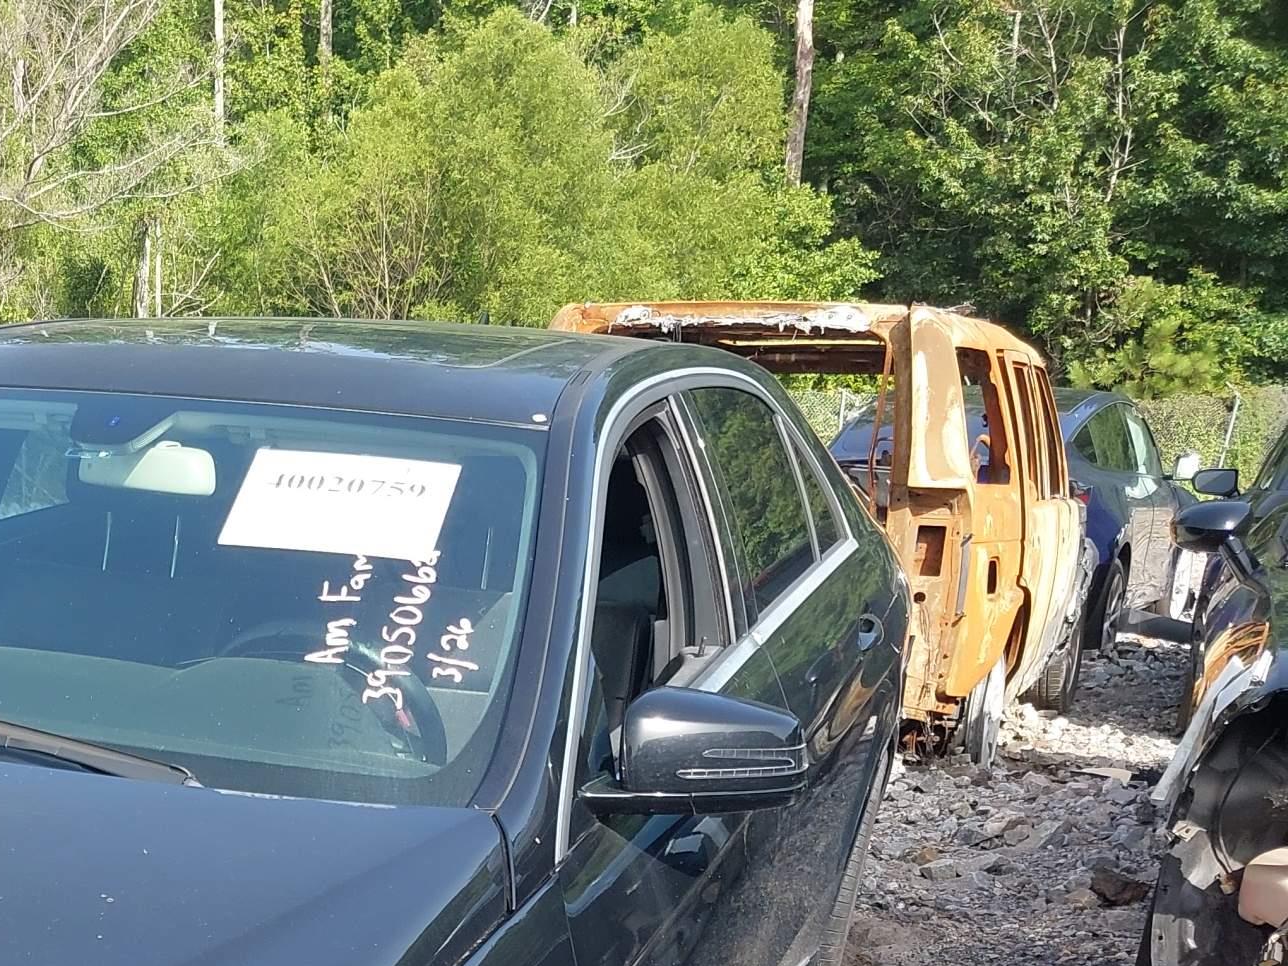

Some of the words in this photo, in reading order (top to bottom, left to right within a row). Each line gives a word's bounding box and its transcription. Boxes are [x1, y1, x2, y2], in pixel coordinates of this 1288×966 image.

[267, 472, 428, 498] 40020759
[304, 617, 358, 664] Am
[427, 617, 480, 683] 3/26
